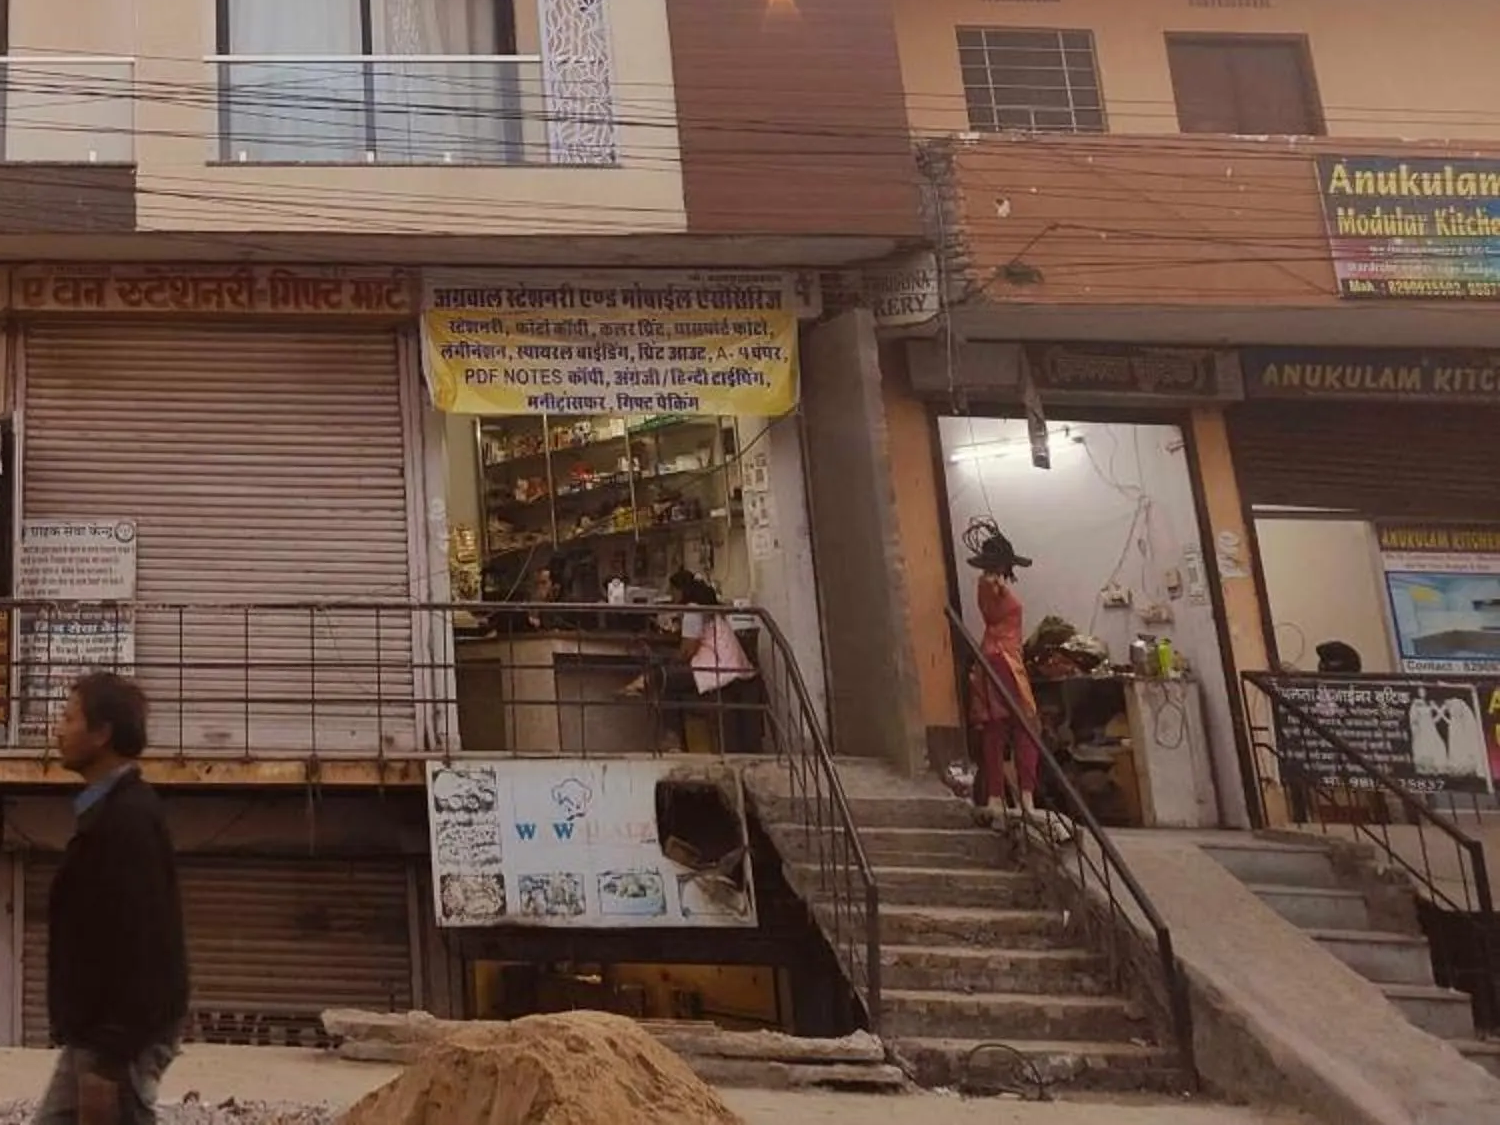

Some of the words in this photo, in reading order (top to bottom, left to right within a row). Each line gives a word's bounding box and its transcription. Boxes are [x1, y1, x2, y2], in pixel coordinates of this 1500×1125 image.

[1337, 206, 1428, 236] Modular
[18, 276, 46, 308] ए
[434, 287, 502, 308] अग्रवाल
[506, 281, 575, 308] स्टेशनरी
[465, 368, 499, 385] PDF
[503, 368, 563, 386] NOTES
[1262, 363, 1421, 390] ANUKULAM
[1433, 367, 1500, 392] KITC
